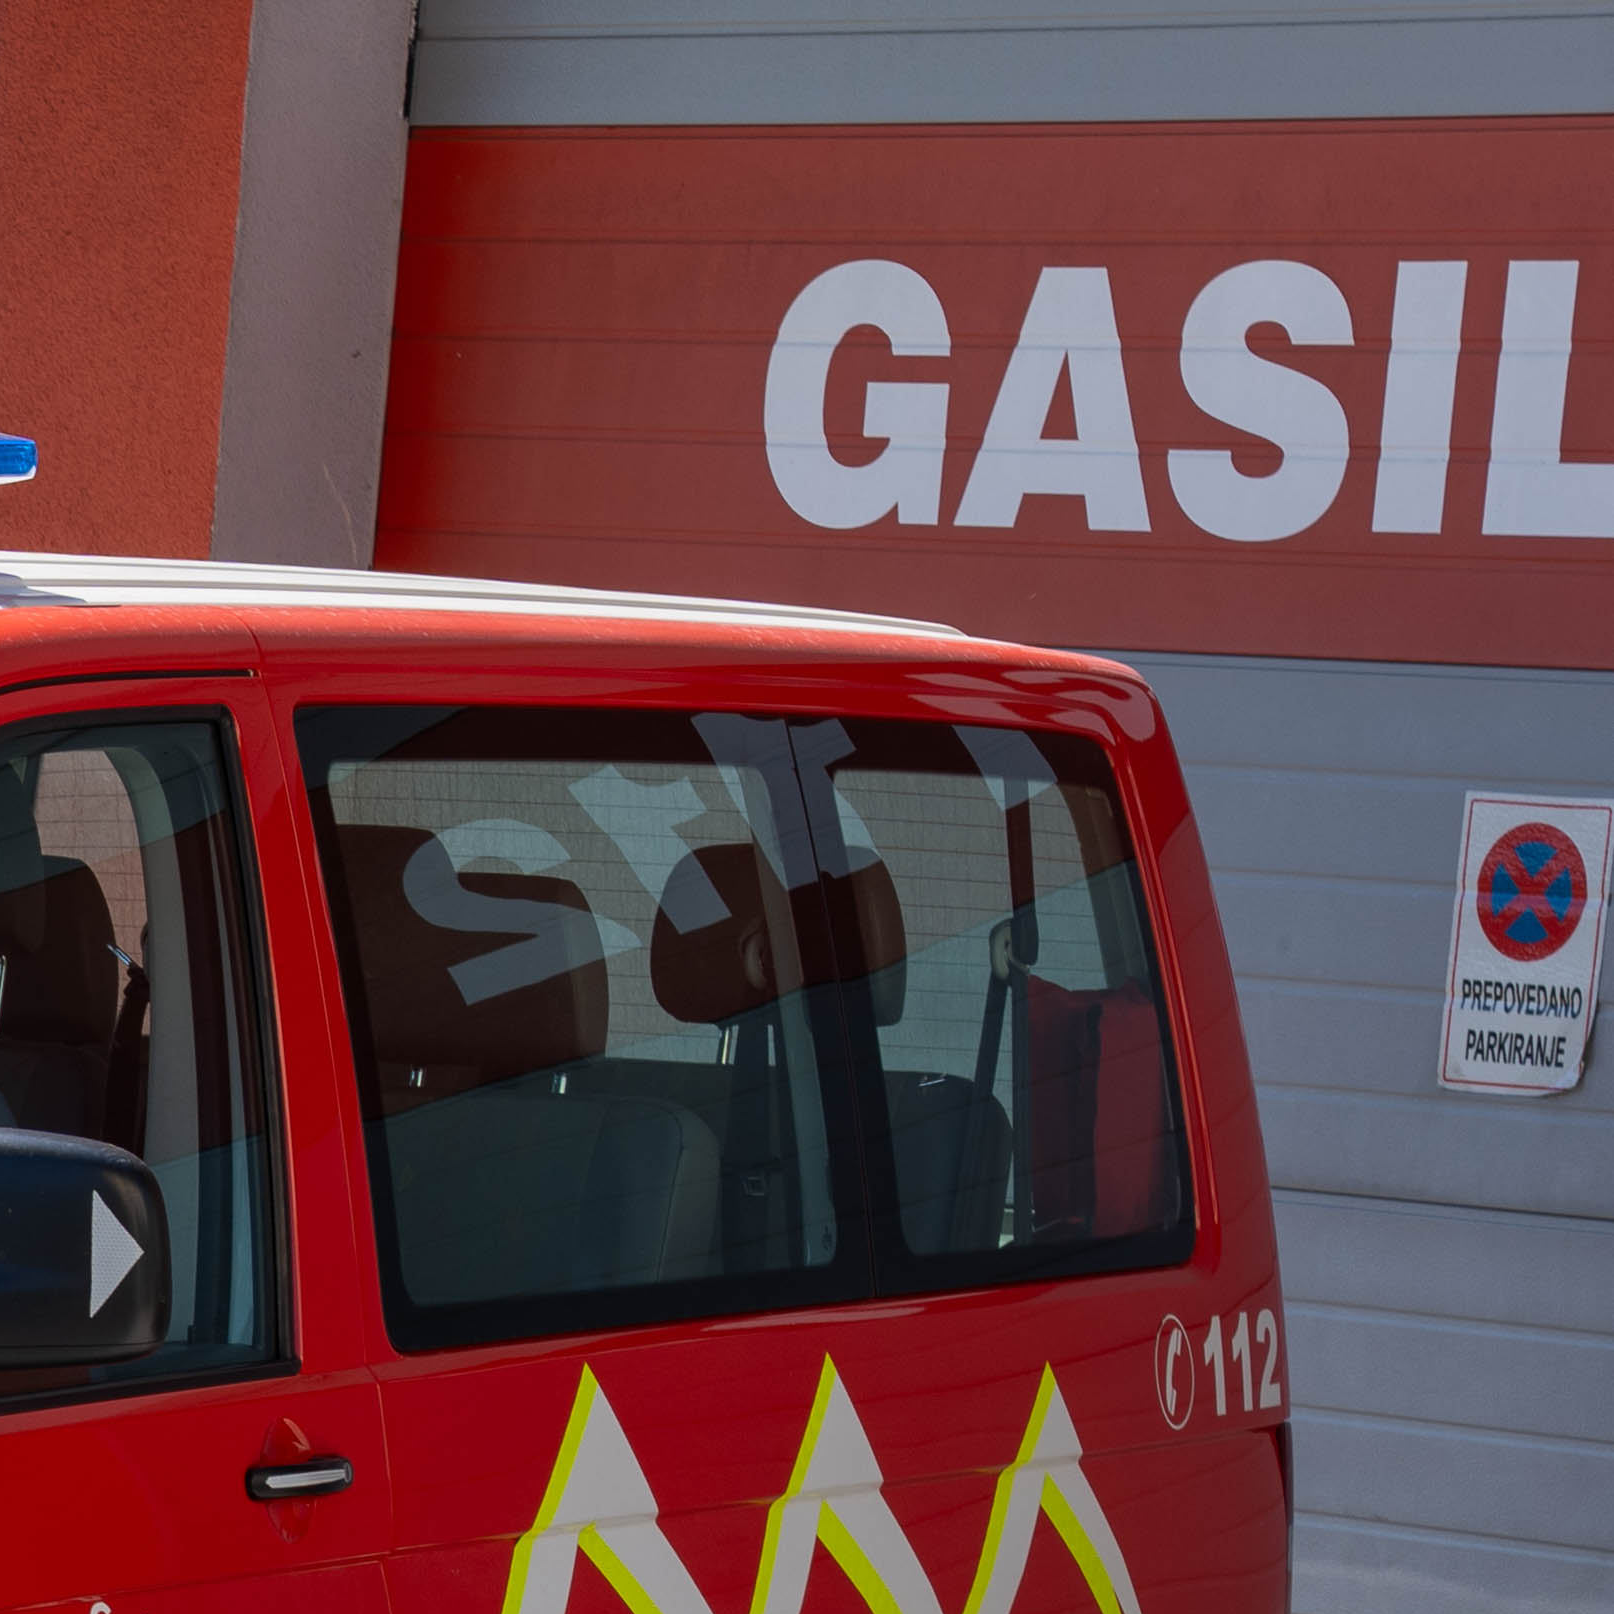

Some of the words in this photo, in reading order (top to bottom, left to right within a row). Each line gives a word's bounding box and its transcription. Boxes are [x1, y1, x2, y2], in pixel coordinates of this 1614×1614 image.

[1461, 979, 1582, 1019] PREPOVEDANO
[1465, 1030, 1566, 1068] PARKIRANJE
[1204, 1308, 1281, 1416] 112
